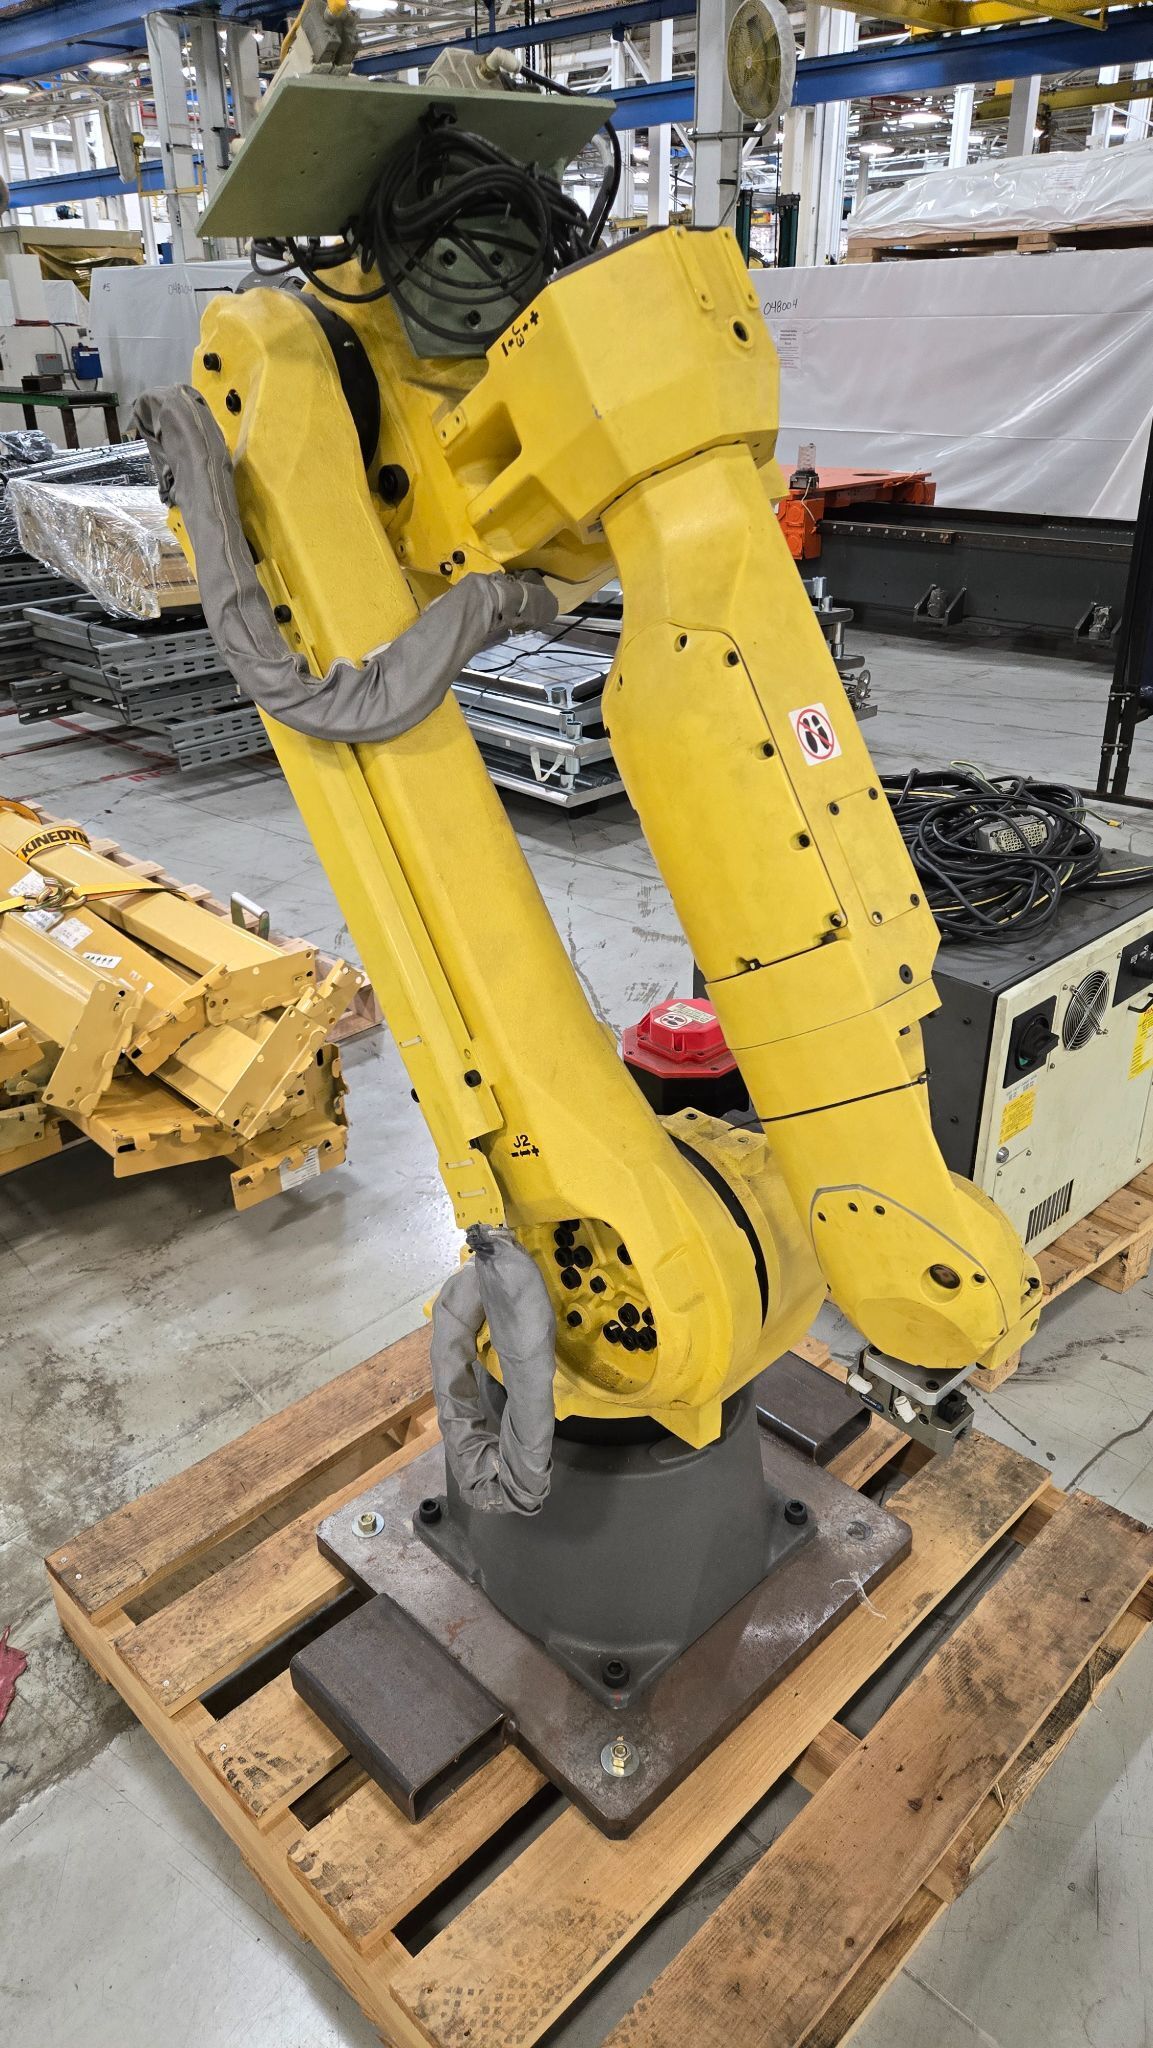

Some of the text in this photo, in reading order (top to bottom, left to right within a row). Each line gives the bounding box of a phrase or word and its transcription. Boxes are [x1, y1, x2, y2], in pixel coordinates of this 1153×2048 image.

[763, 298, 799, 316] 048004
[511, 325, 525, 348] J3
[513, 1134, 531, 1149] J2
